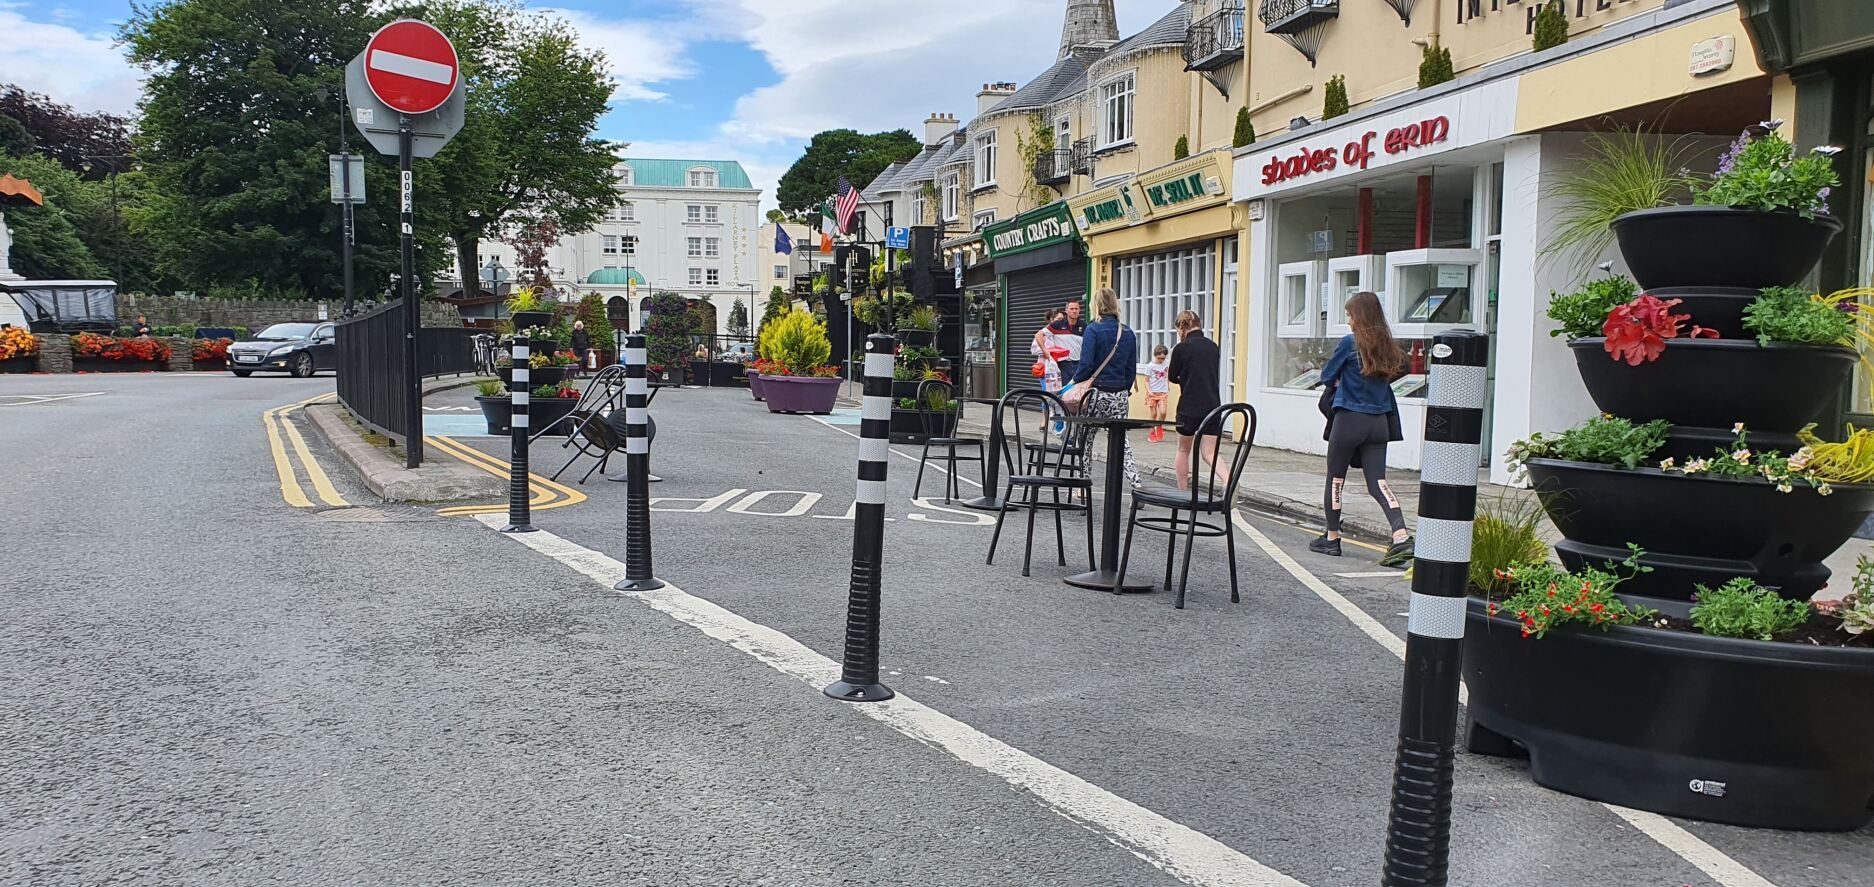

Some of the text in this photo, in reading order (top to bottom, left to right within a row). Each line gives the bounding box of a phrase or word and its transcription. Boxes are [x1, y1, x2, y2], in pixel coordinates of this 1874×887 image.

[1261, 146, 1338, 187] shades
[1343, 130, 1377, 170] of
[993, 228, 1025, 251] COUNTRY
[1027, 216, 1060, 243] CRAFTS
